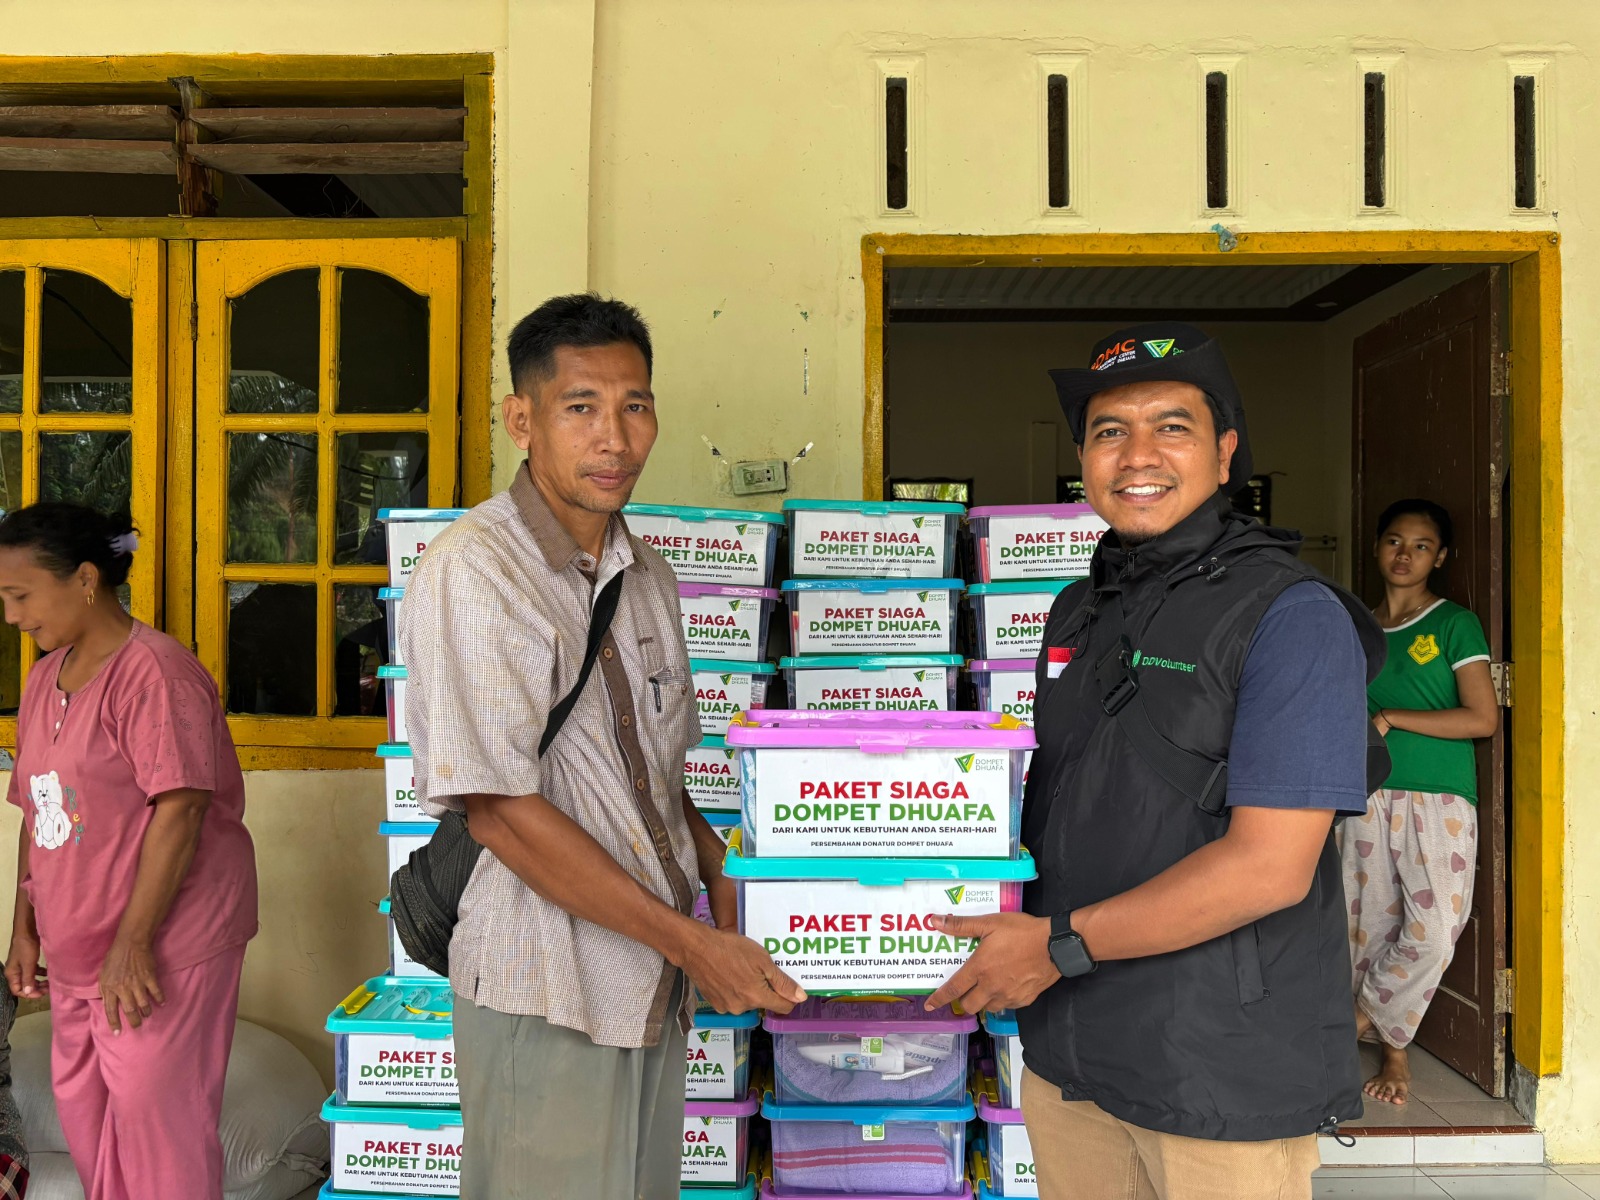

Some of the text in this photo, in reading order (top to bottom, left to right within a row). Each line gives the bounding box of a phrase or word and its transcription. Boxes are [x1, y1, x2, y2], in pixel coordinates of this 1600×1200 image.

[643, 535, 742, 550] PAKET SIAGA
[820, 530, 920, 544] PAKET SIAGA
[1016, 532, 1065, 544] PAKET
[804, 543, 935, 557] DOMPET DHUAFA
[1000, 545, 1065, 558] DOMPET
[695, 550, 757, 564] DHUAFA
[825, 608, 925, 618] PAKET SIAGA
[689, 614, 736, 626] SIAGA
[810, 620, 941, 632] DOMPET DHUAFA
[688, 627, 750, 640] DHUAFA
[997, 626, 1044, 638] DOMP
[1142, 656, 1196, 672] DDVolunteer
[696, 689, 727, 700] AGA
[822, 687, 923, 699] PAKET SIAGA
[697, 702, 740, 713] UAFA
[807, 700, 939, 710] DOMPET DHUAFA
[684, 762, 731, 775] SIAGA
[800, 781, 969, 798] PAKET SIAGA
[774, 803, 995, 821] DOMPET DHUAFA
[790, 915, 872, 932] PAKET
[764, 937, 871, 954] DOMPET
[379, 1051, 436, 1063] PAKET
[361, 1065, 435, 1078] DOMPET
[364, 1141, 422, 1154] PAKET
[682, 1145, 726, 1158] UAFA
[347, 1154, 461, 1171] DOMPET DHU
